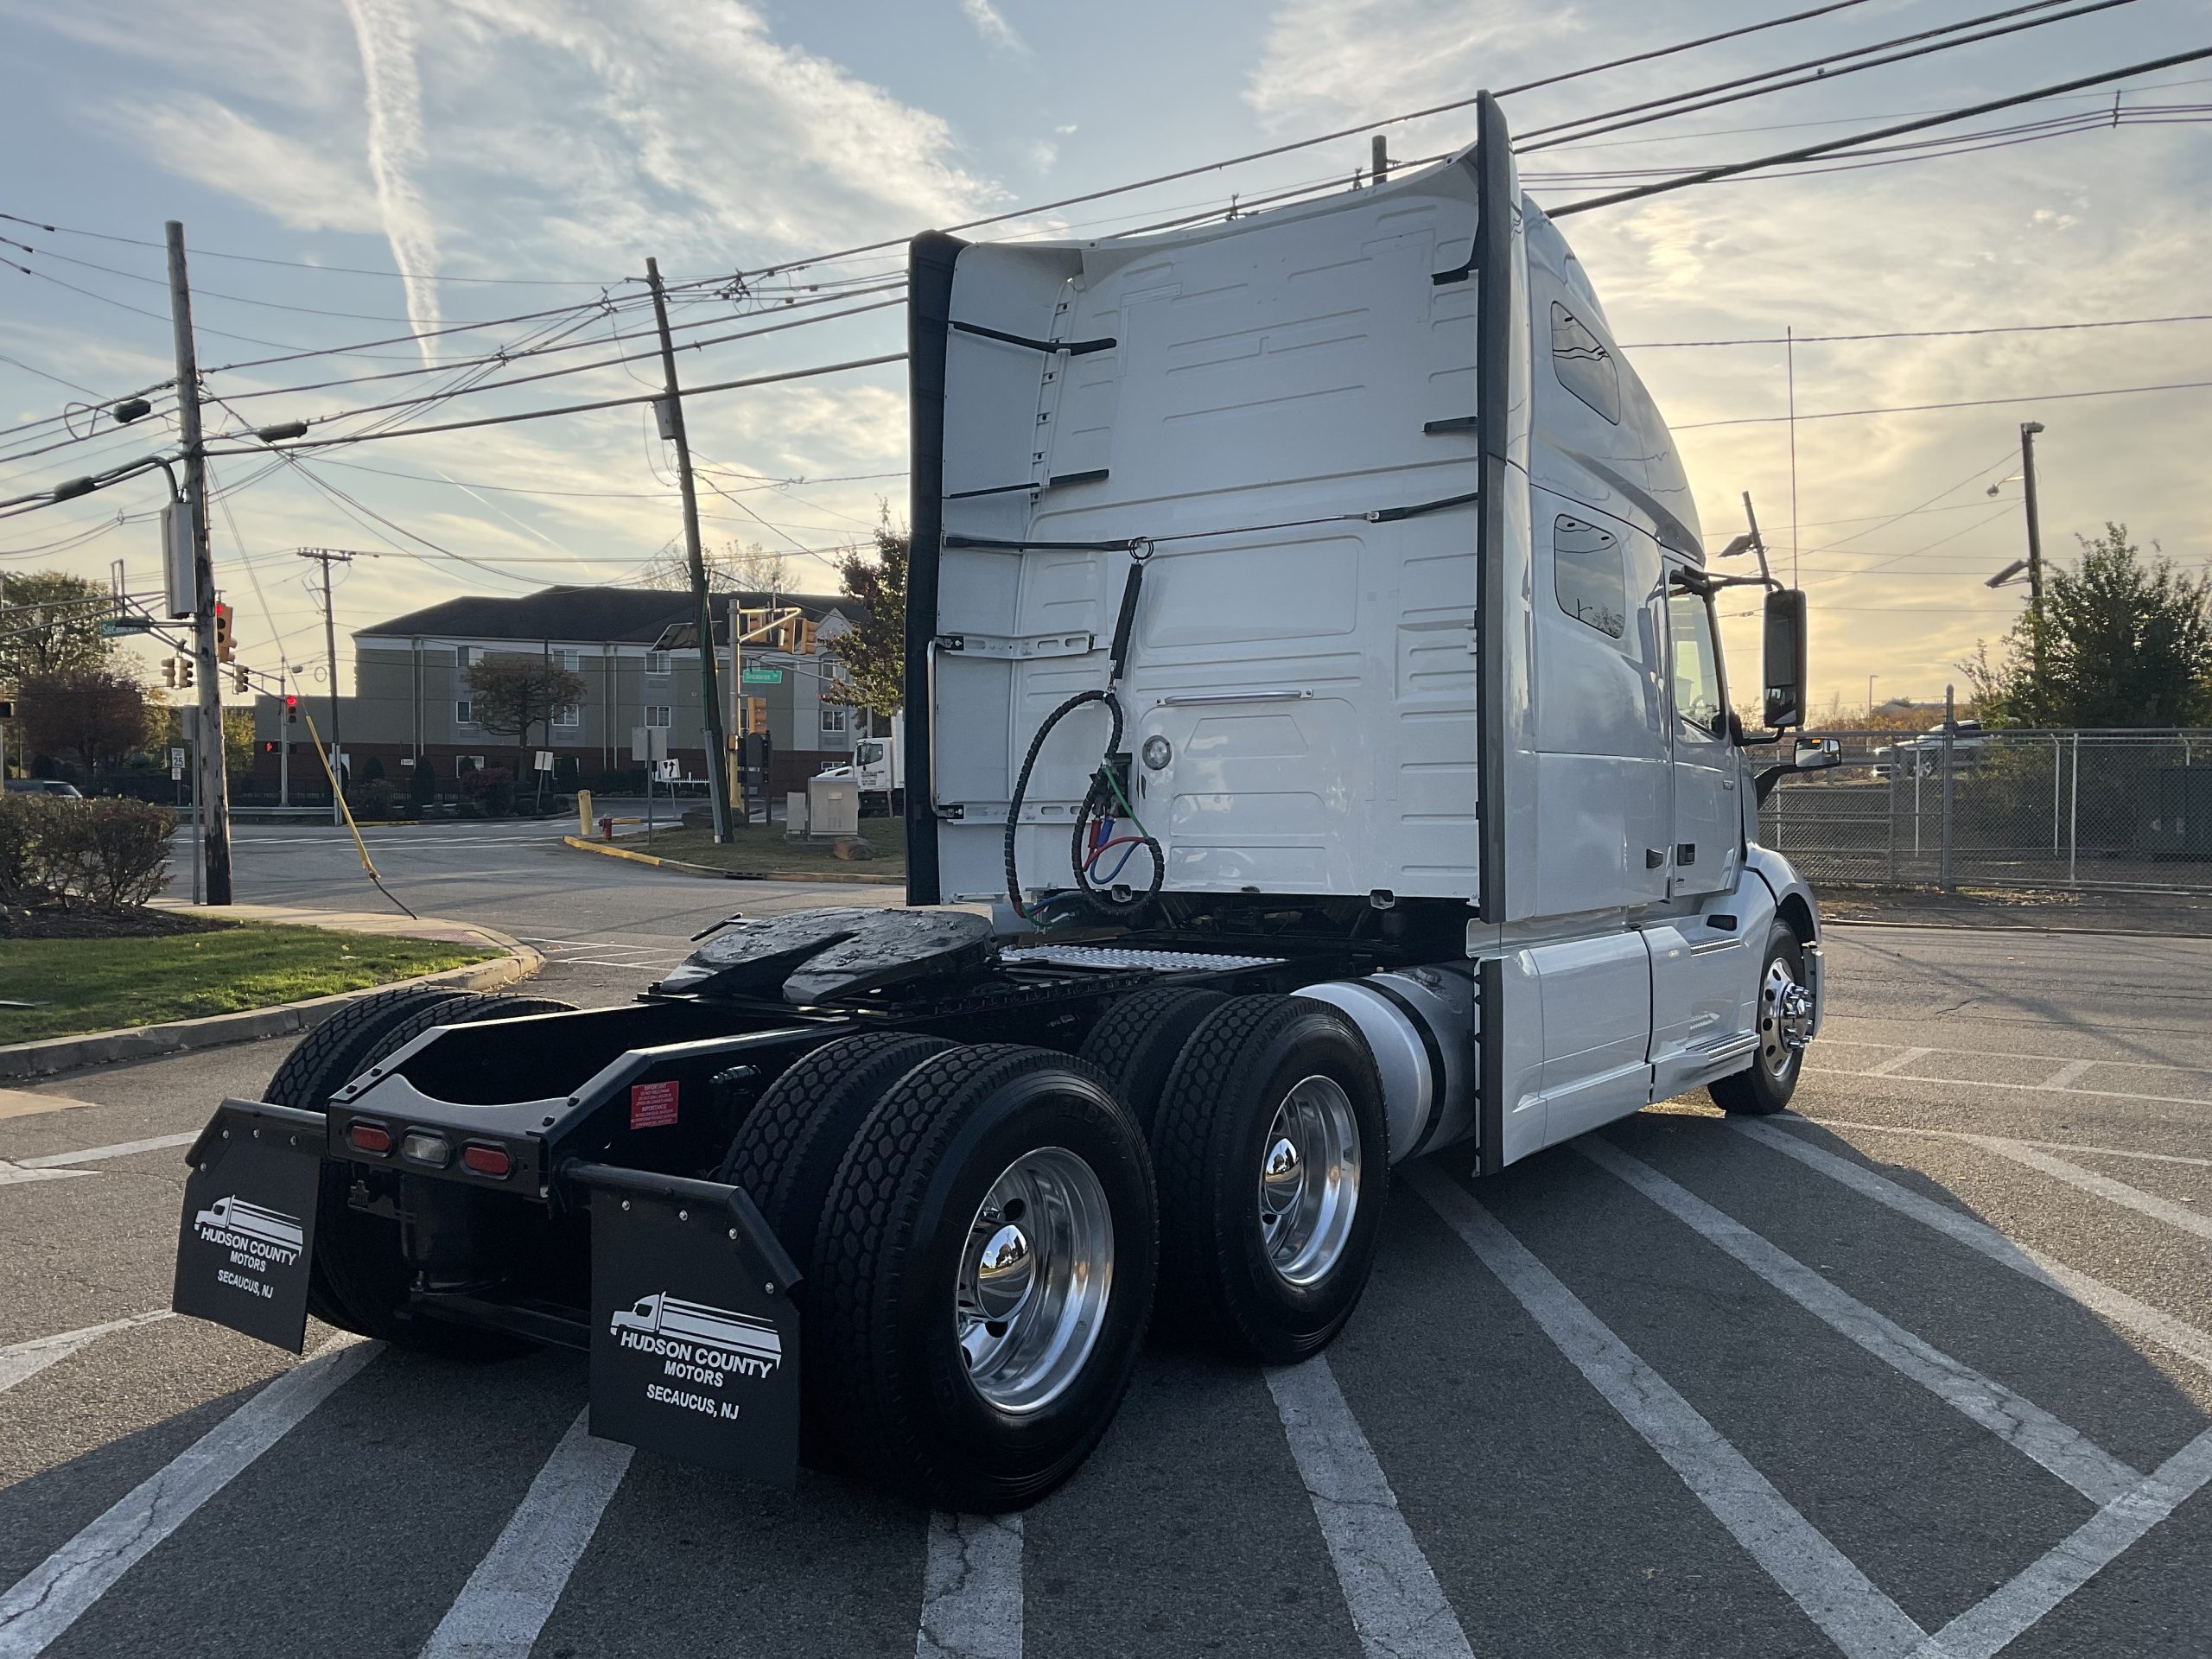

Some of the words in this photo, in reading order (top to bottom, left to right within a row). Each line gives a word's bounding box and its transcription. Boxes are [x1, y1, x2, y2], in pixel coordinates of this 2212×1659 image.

[173, 757, 183, 766] 25
[200, 1227, 249, 1251] HUDSON
[250, 1240, 297, 1266] COUNTY
[230, 1250, 266, 1273] MOTORS
[217, 1269, 260, 1297] SECAUCUS,
[261, 1284, 274, 1299] NJ
[620, 1331, 692, 1362] HUDSON
[695, 1348, 772, 1379] COUNTY
[664, 1360, 724, 1388] MOTORS
[646, 1383, 717, 1418] SECAUCUS,
[721, 1402, 740, 1420] NJ
